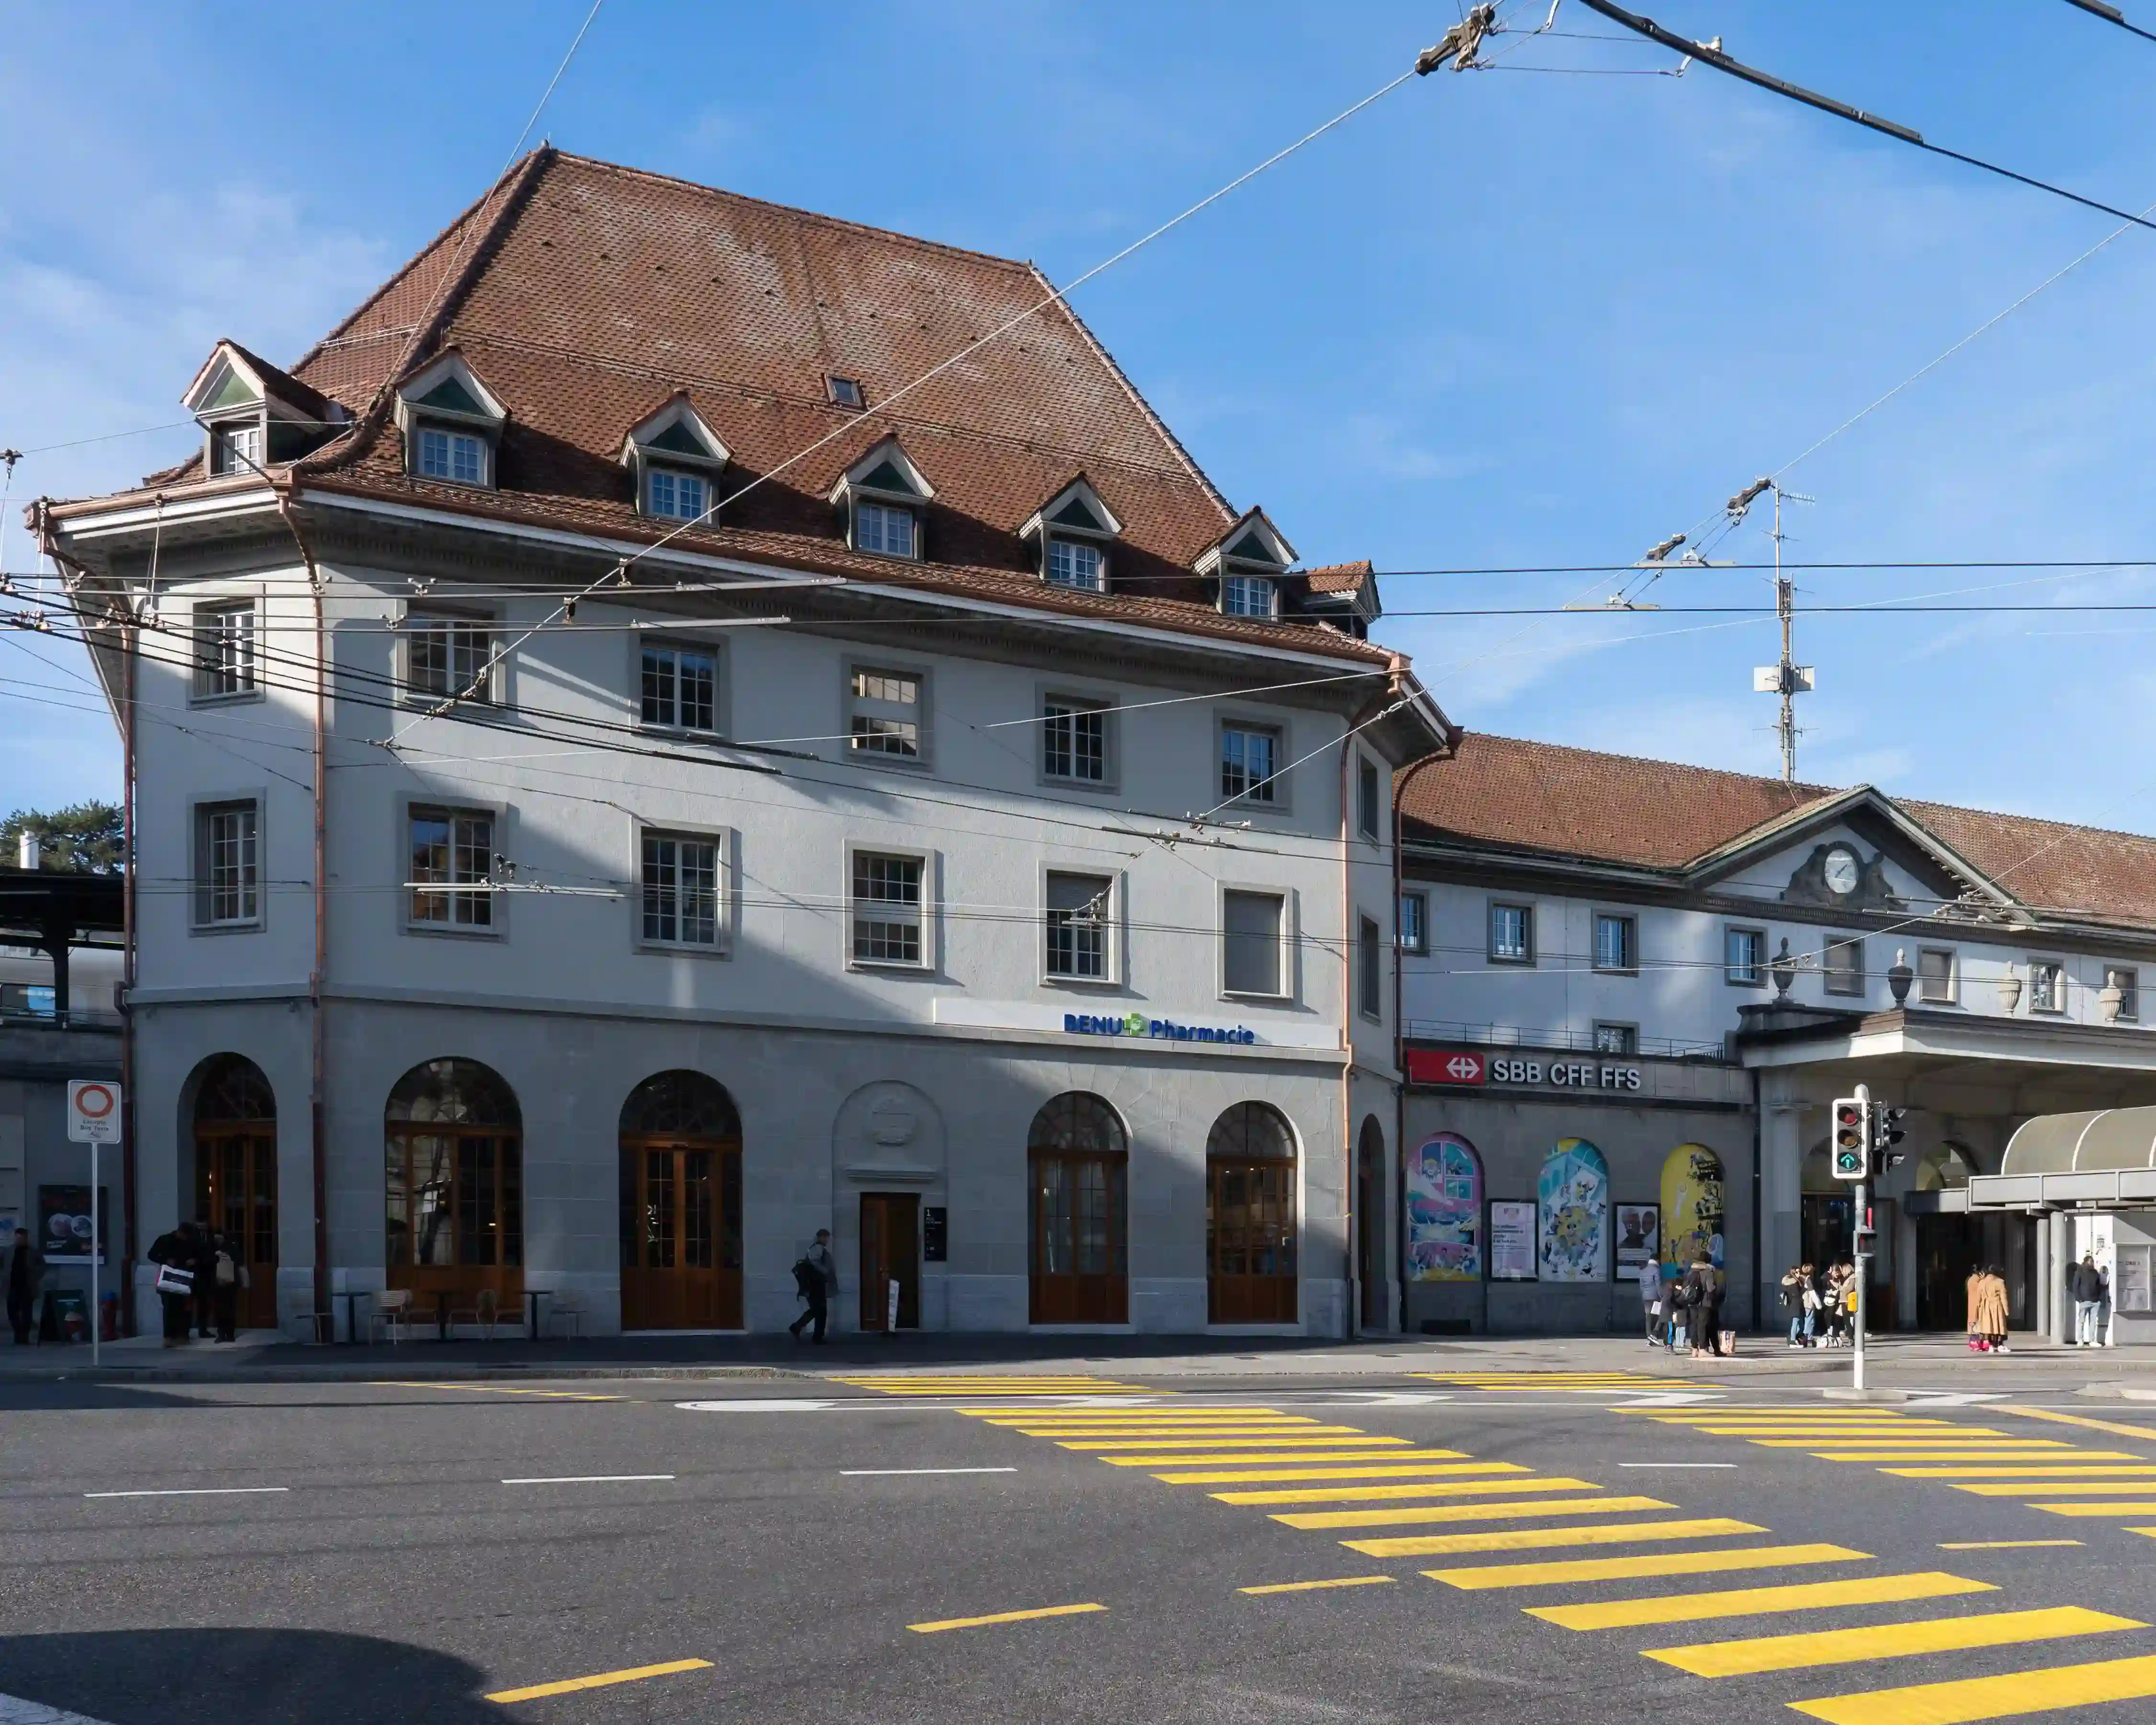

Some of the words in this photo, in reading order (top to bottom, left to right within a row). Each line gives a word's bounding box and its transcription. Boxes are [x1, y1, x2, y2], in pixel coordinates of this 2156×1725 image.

[1064, 1013, 1122, 1035] BENU
[1151, 1019, 1254, 1044] Pharmacie
[1493, 1059, 1542, 1083] SBB
[1550, 1063, 1593, 1086] CFF
[1601, 1067, 1641, 1090] FFS
